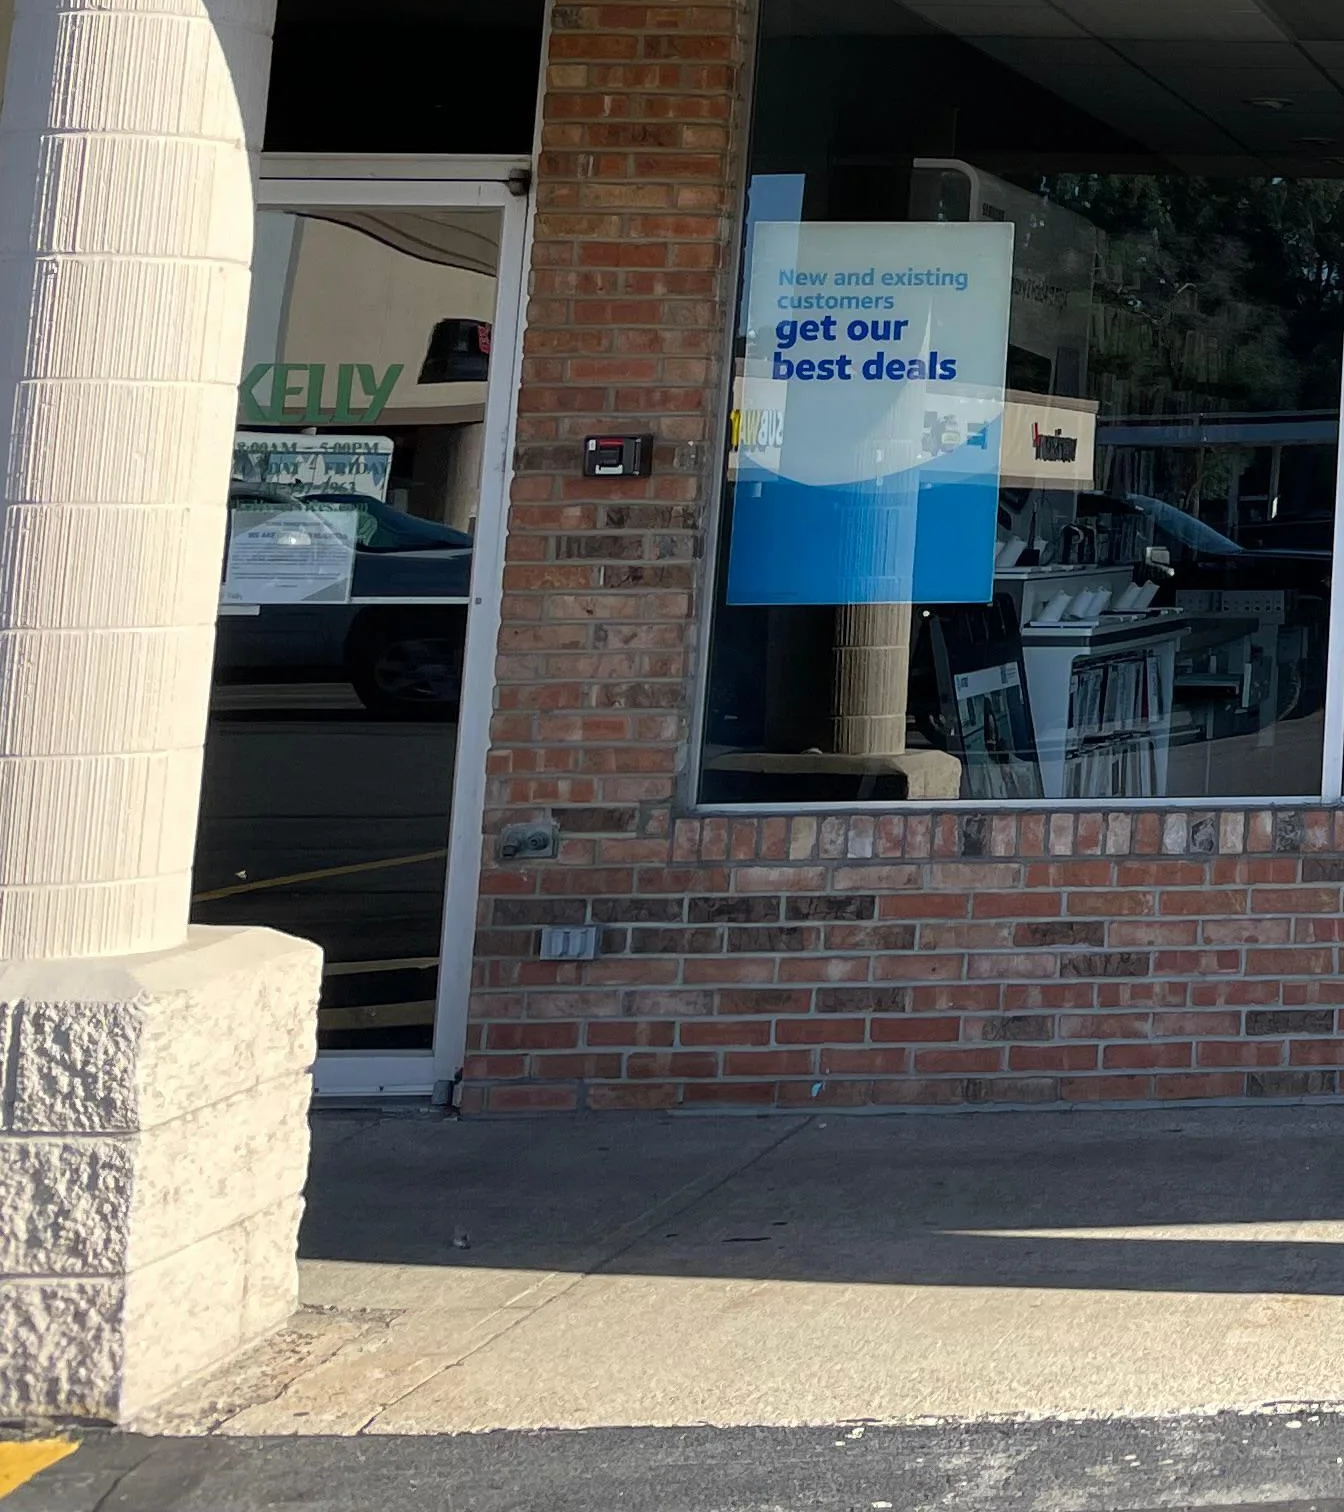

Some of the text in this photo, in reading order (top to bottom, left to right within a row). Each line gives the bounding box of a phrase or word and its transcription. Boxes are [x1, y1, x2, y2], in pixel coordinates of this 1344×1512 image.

[778, 268, 969, 291] New and existing
[777, 292, 895, 310] customers
[775, 315, 909, 349] get our
[771, 351, 957, 380] best deals
[239, 363, 405, 424] KELLY
